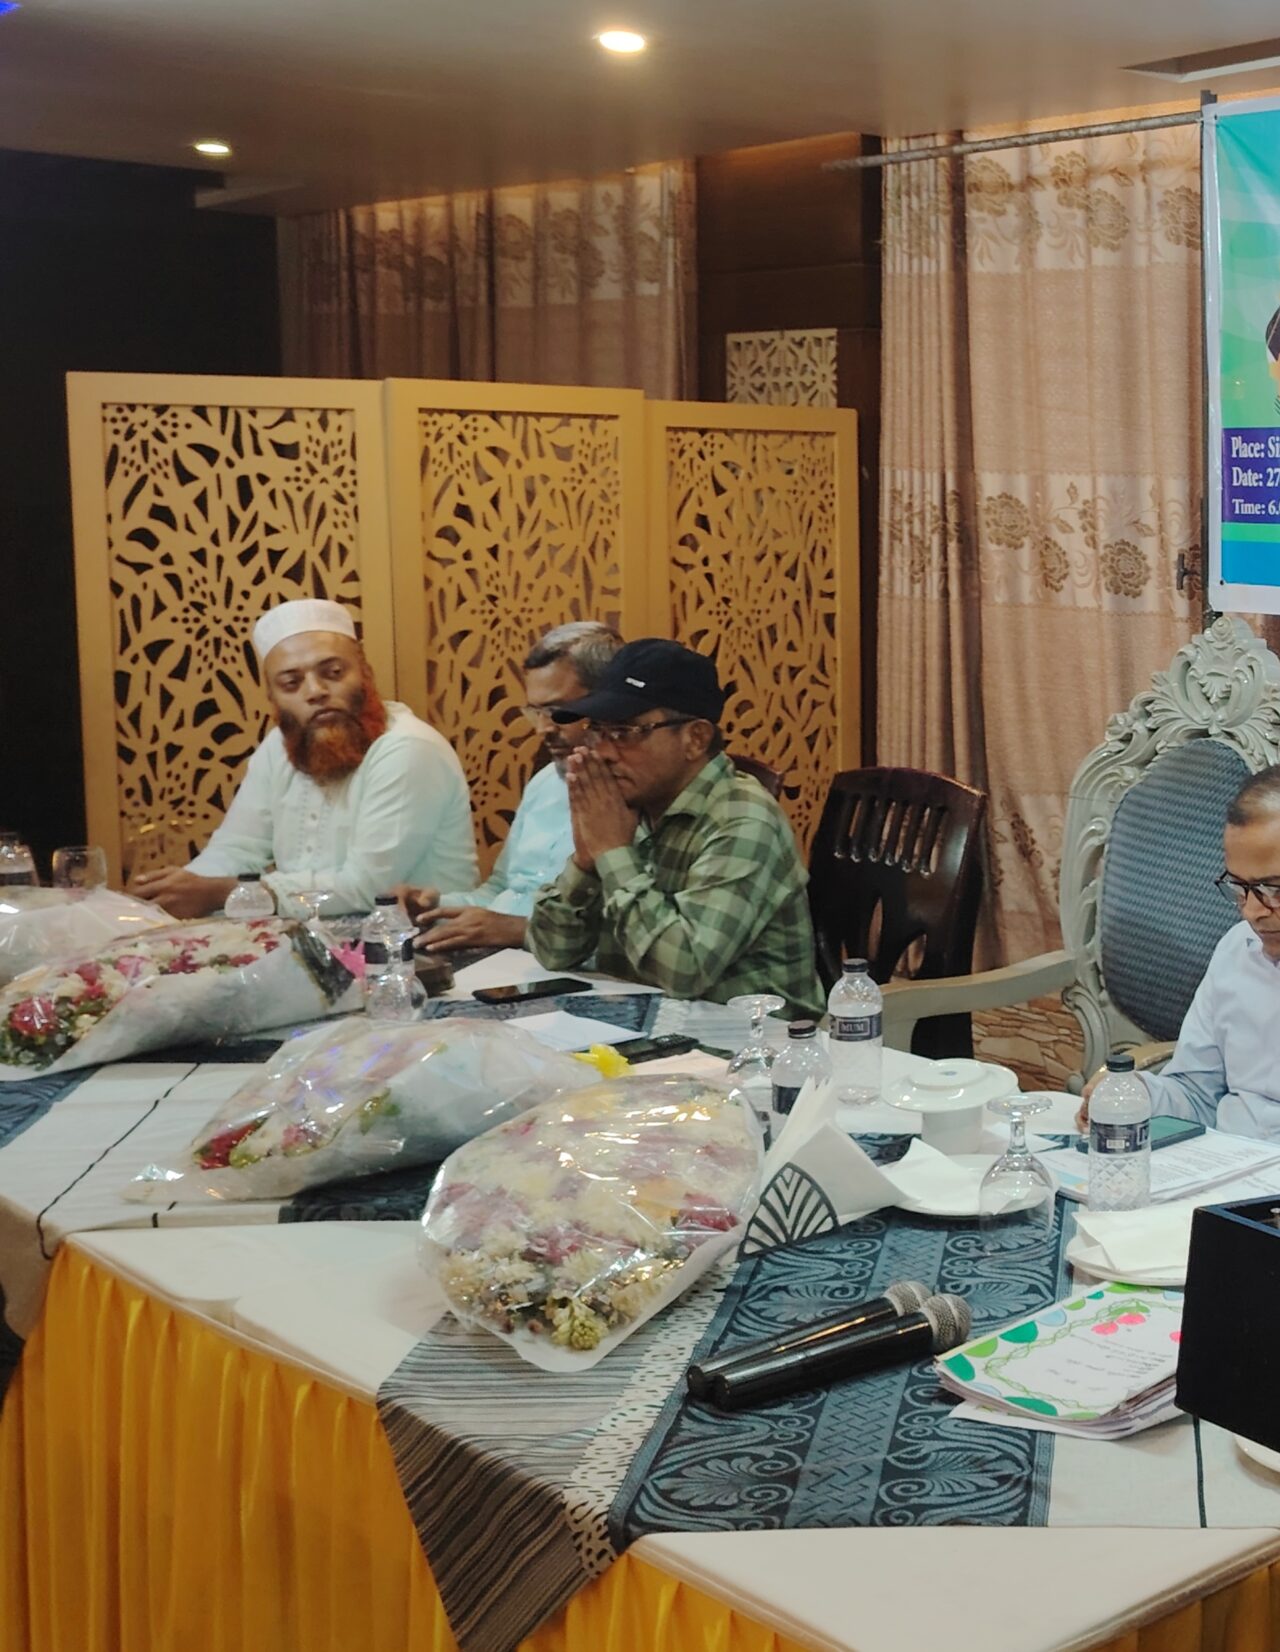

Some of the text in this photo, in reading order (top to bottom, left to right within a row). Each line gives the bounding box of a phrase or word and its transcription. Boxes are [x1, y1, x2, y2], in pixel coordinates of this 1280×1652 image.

[1231, 435, 1265, 460] Place:
[1232, 467, 1263, 487] Date:
[1232, 499, 1265, 515] Time:
